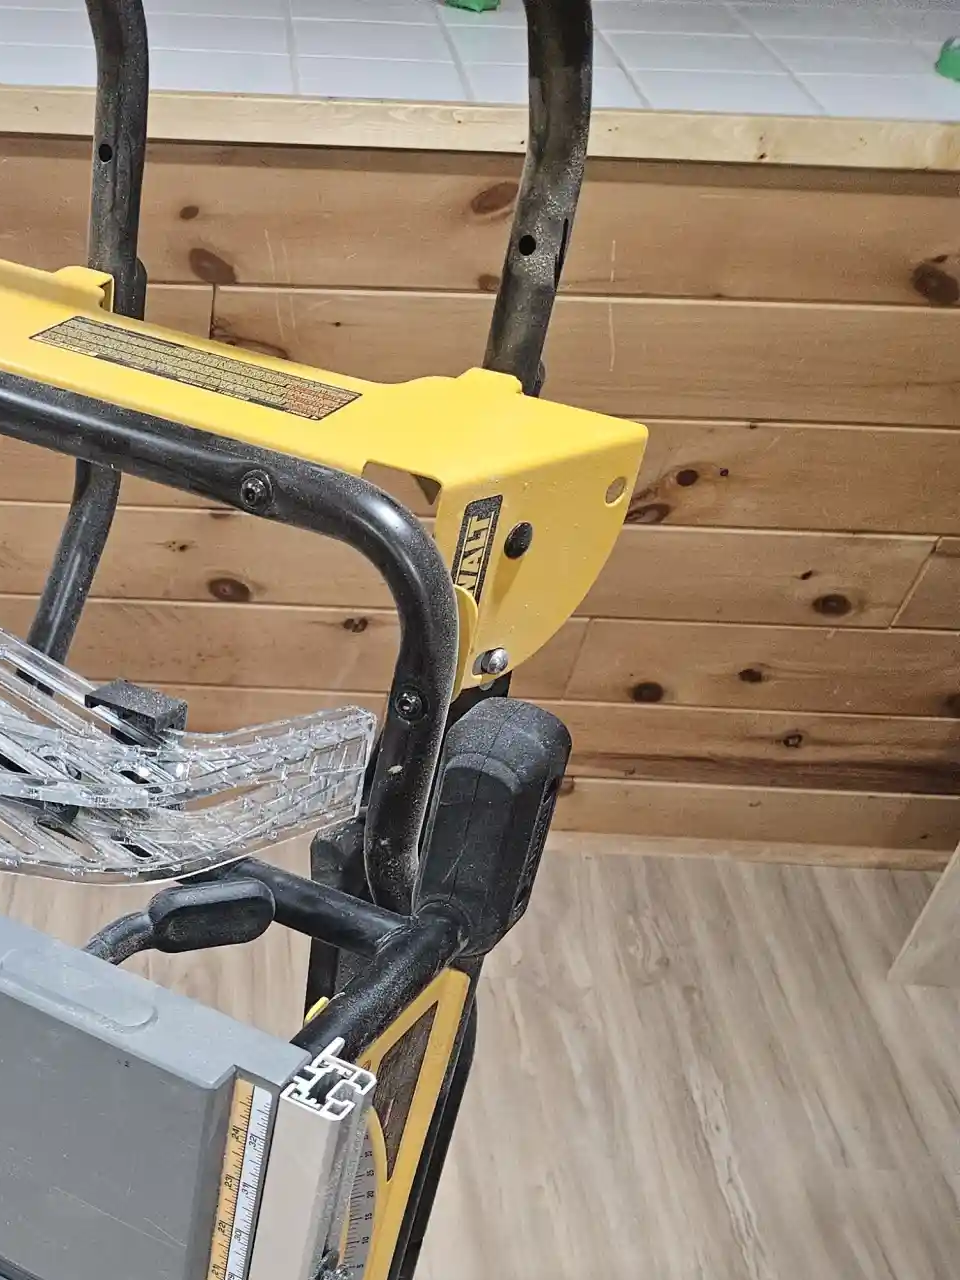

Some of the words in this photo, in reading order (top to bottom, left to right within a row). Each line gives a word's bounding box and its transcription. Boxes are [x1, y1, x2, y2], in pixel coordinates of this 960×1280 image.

[231, 1125, 240, 1140] 24
[248, 1133, 257, 1148] 32
[224, 1174, 233, 1188] 23
[241, 1182, 250, 1195] 31
[218, 1221, 226, 1234] 22
[234, 1228, 242, 1241] 30
[211, 1264, 220, 1276] 21
